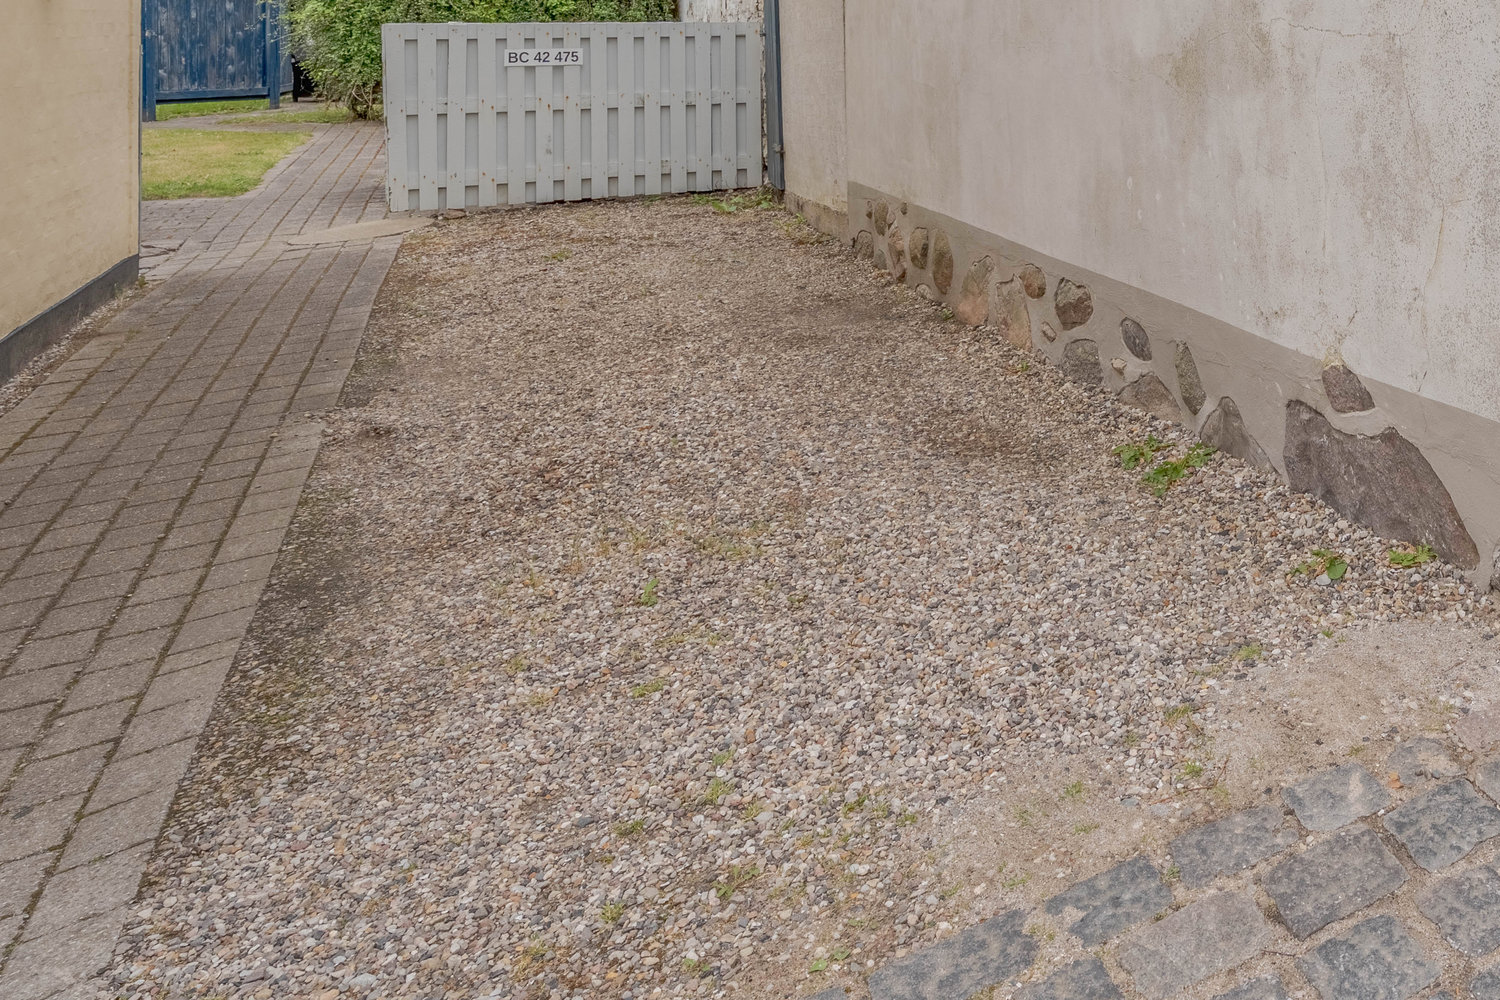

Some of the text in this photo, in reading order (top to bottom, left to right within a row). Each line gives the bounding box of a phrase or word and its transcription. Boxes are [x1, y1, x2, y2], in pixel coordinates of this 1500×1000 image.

[508, 51, 579, 63] BC 42 475
